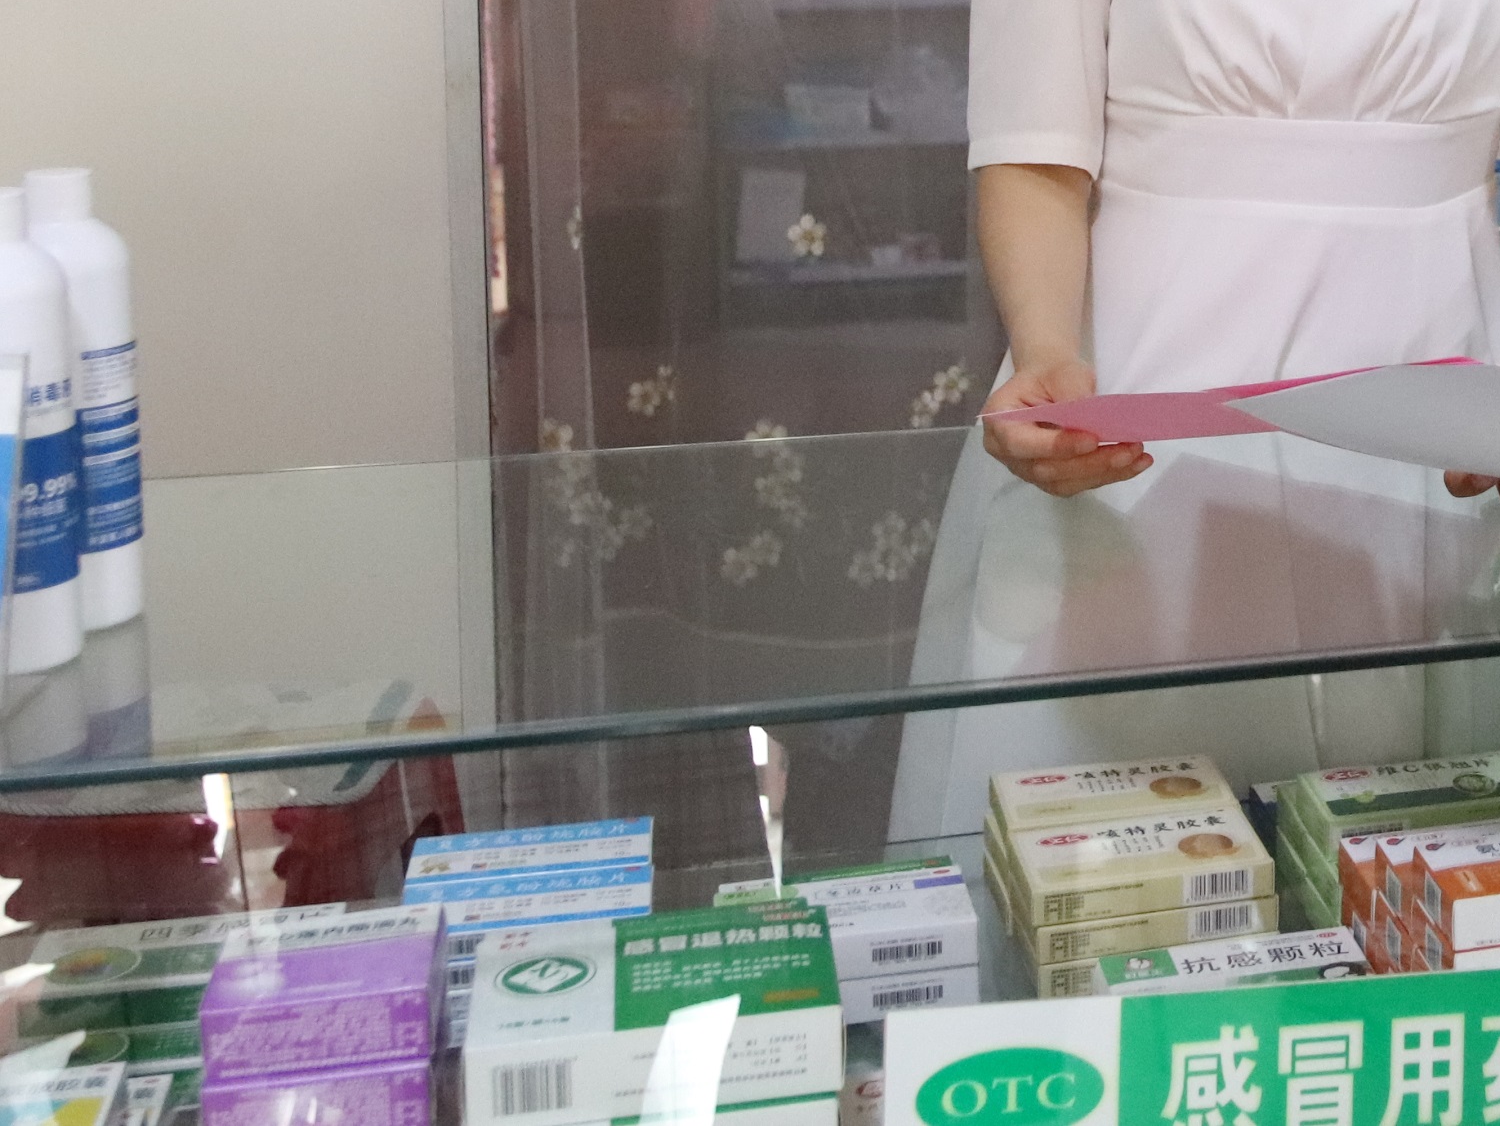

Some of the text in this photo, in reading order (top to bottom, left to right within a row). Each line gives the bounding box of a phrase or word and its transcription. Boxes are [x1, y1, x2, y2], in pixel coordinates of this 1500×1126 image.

[1075, 761, 1198, 779] 咳特灵胶囊
[1096, 815, 1226, 838] 咳特灵胶囊
[623, 922, 823, 957] 感冒退热颗粒
[1180, 940, 1350, 975] 抗感颗粒
[940, 1072, 1078, 1117] OTC
